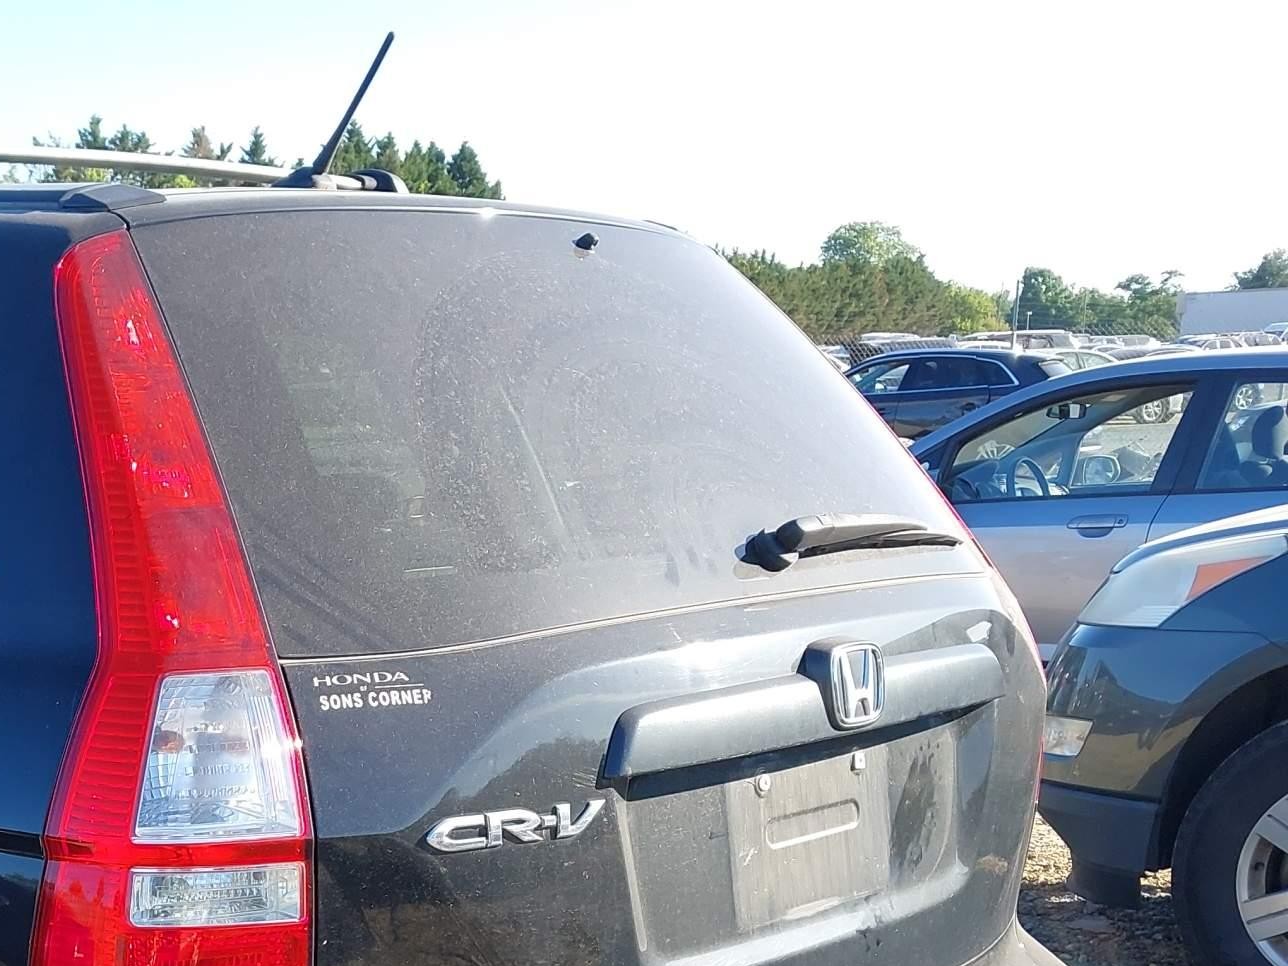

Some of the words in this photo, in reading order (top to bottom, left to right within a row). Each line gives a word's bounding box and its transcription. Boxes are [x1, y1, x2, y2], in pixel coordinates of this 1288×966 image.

[312, 671, 410, 687] HONDA
[319, 692, 364, 711] SONS
[368, 688, 432, 707] CORNER
[426, 799, 606, 852] CR-V
